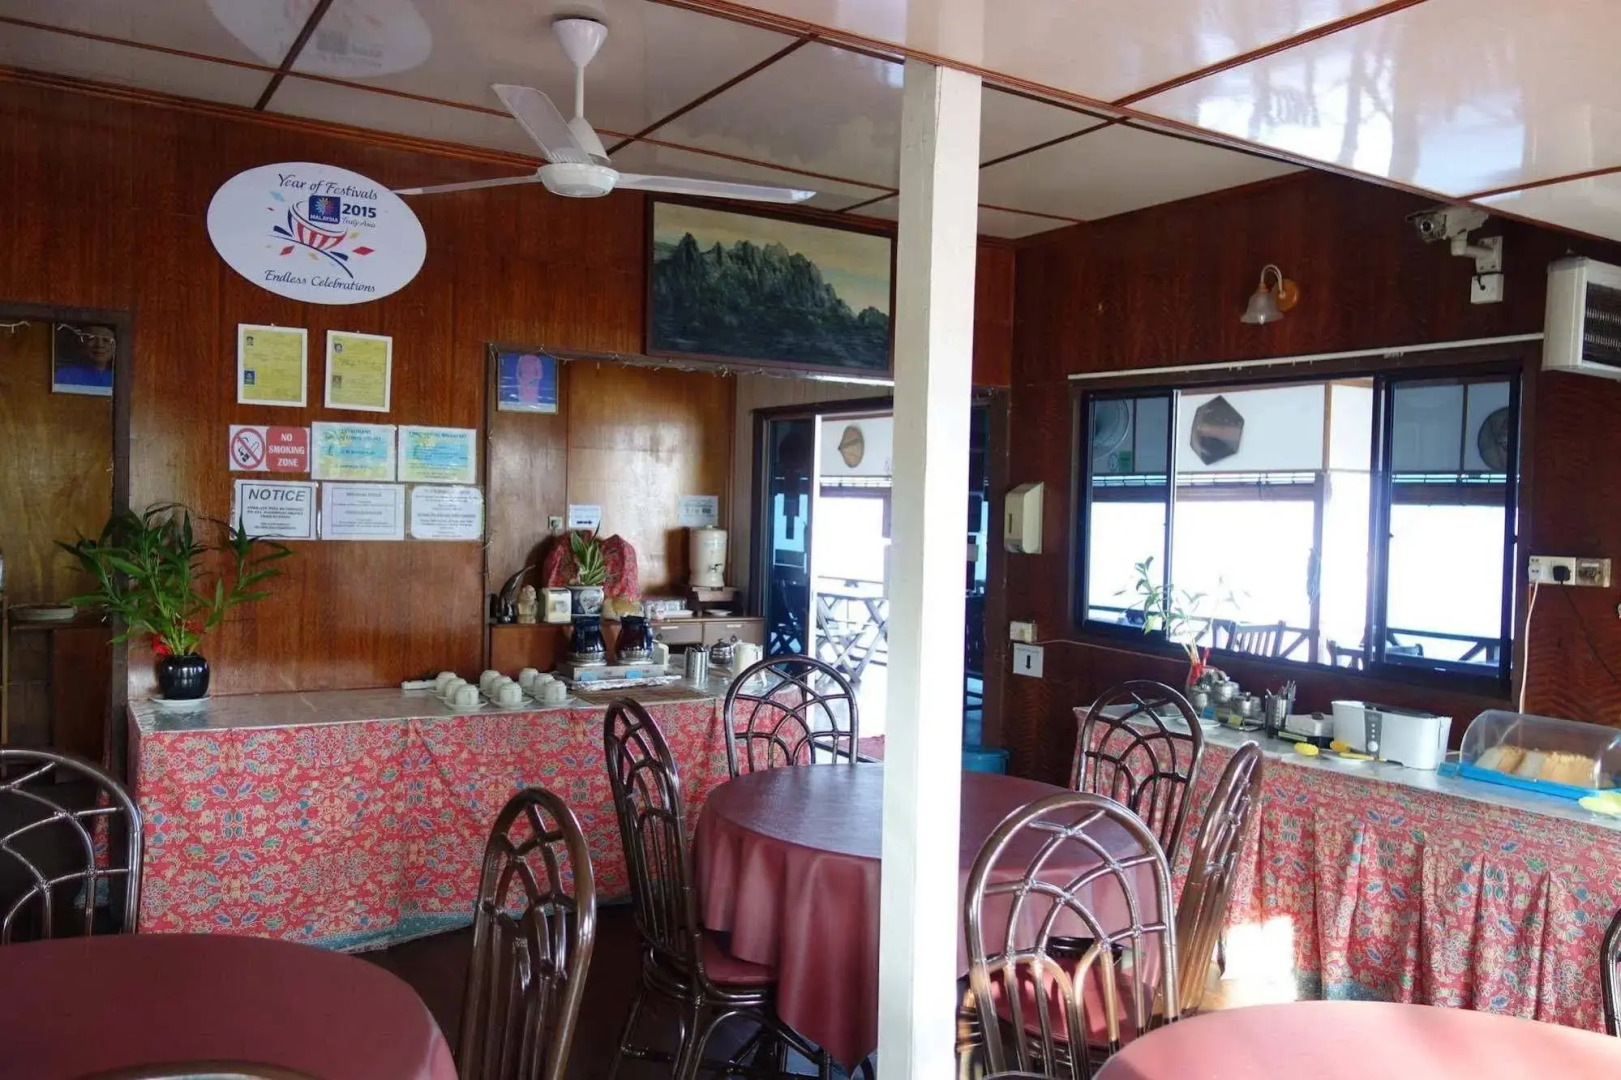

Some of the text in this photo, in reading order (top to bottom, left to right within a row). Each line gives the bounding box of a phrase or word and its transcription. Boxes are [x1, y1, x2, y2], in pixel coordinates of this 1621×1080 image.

[278, 173, 378, 200] Year of Festivals
[342, 203, 377, 218] 2015
[309, 214, 339, 223] MALAYSIA
[341, 217, 376, 229] Truly Asia
[264, 269, 376, 293] Endless Celebrations
[280, 432, 293, 442] NO
[268, 444, 305, 455] SMOKING
[277, 457, 299, 467] ZONE
[248, 488, 306, 502] NOTICE
